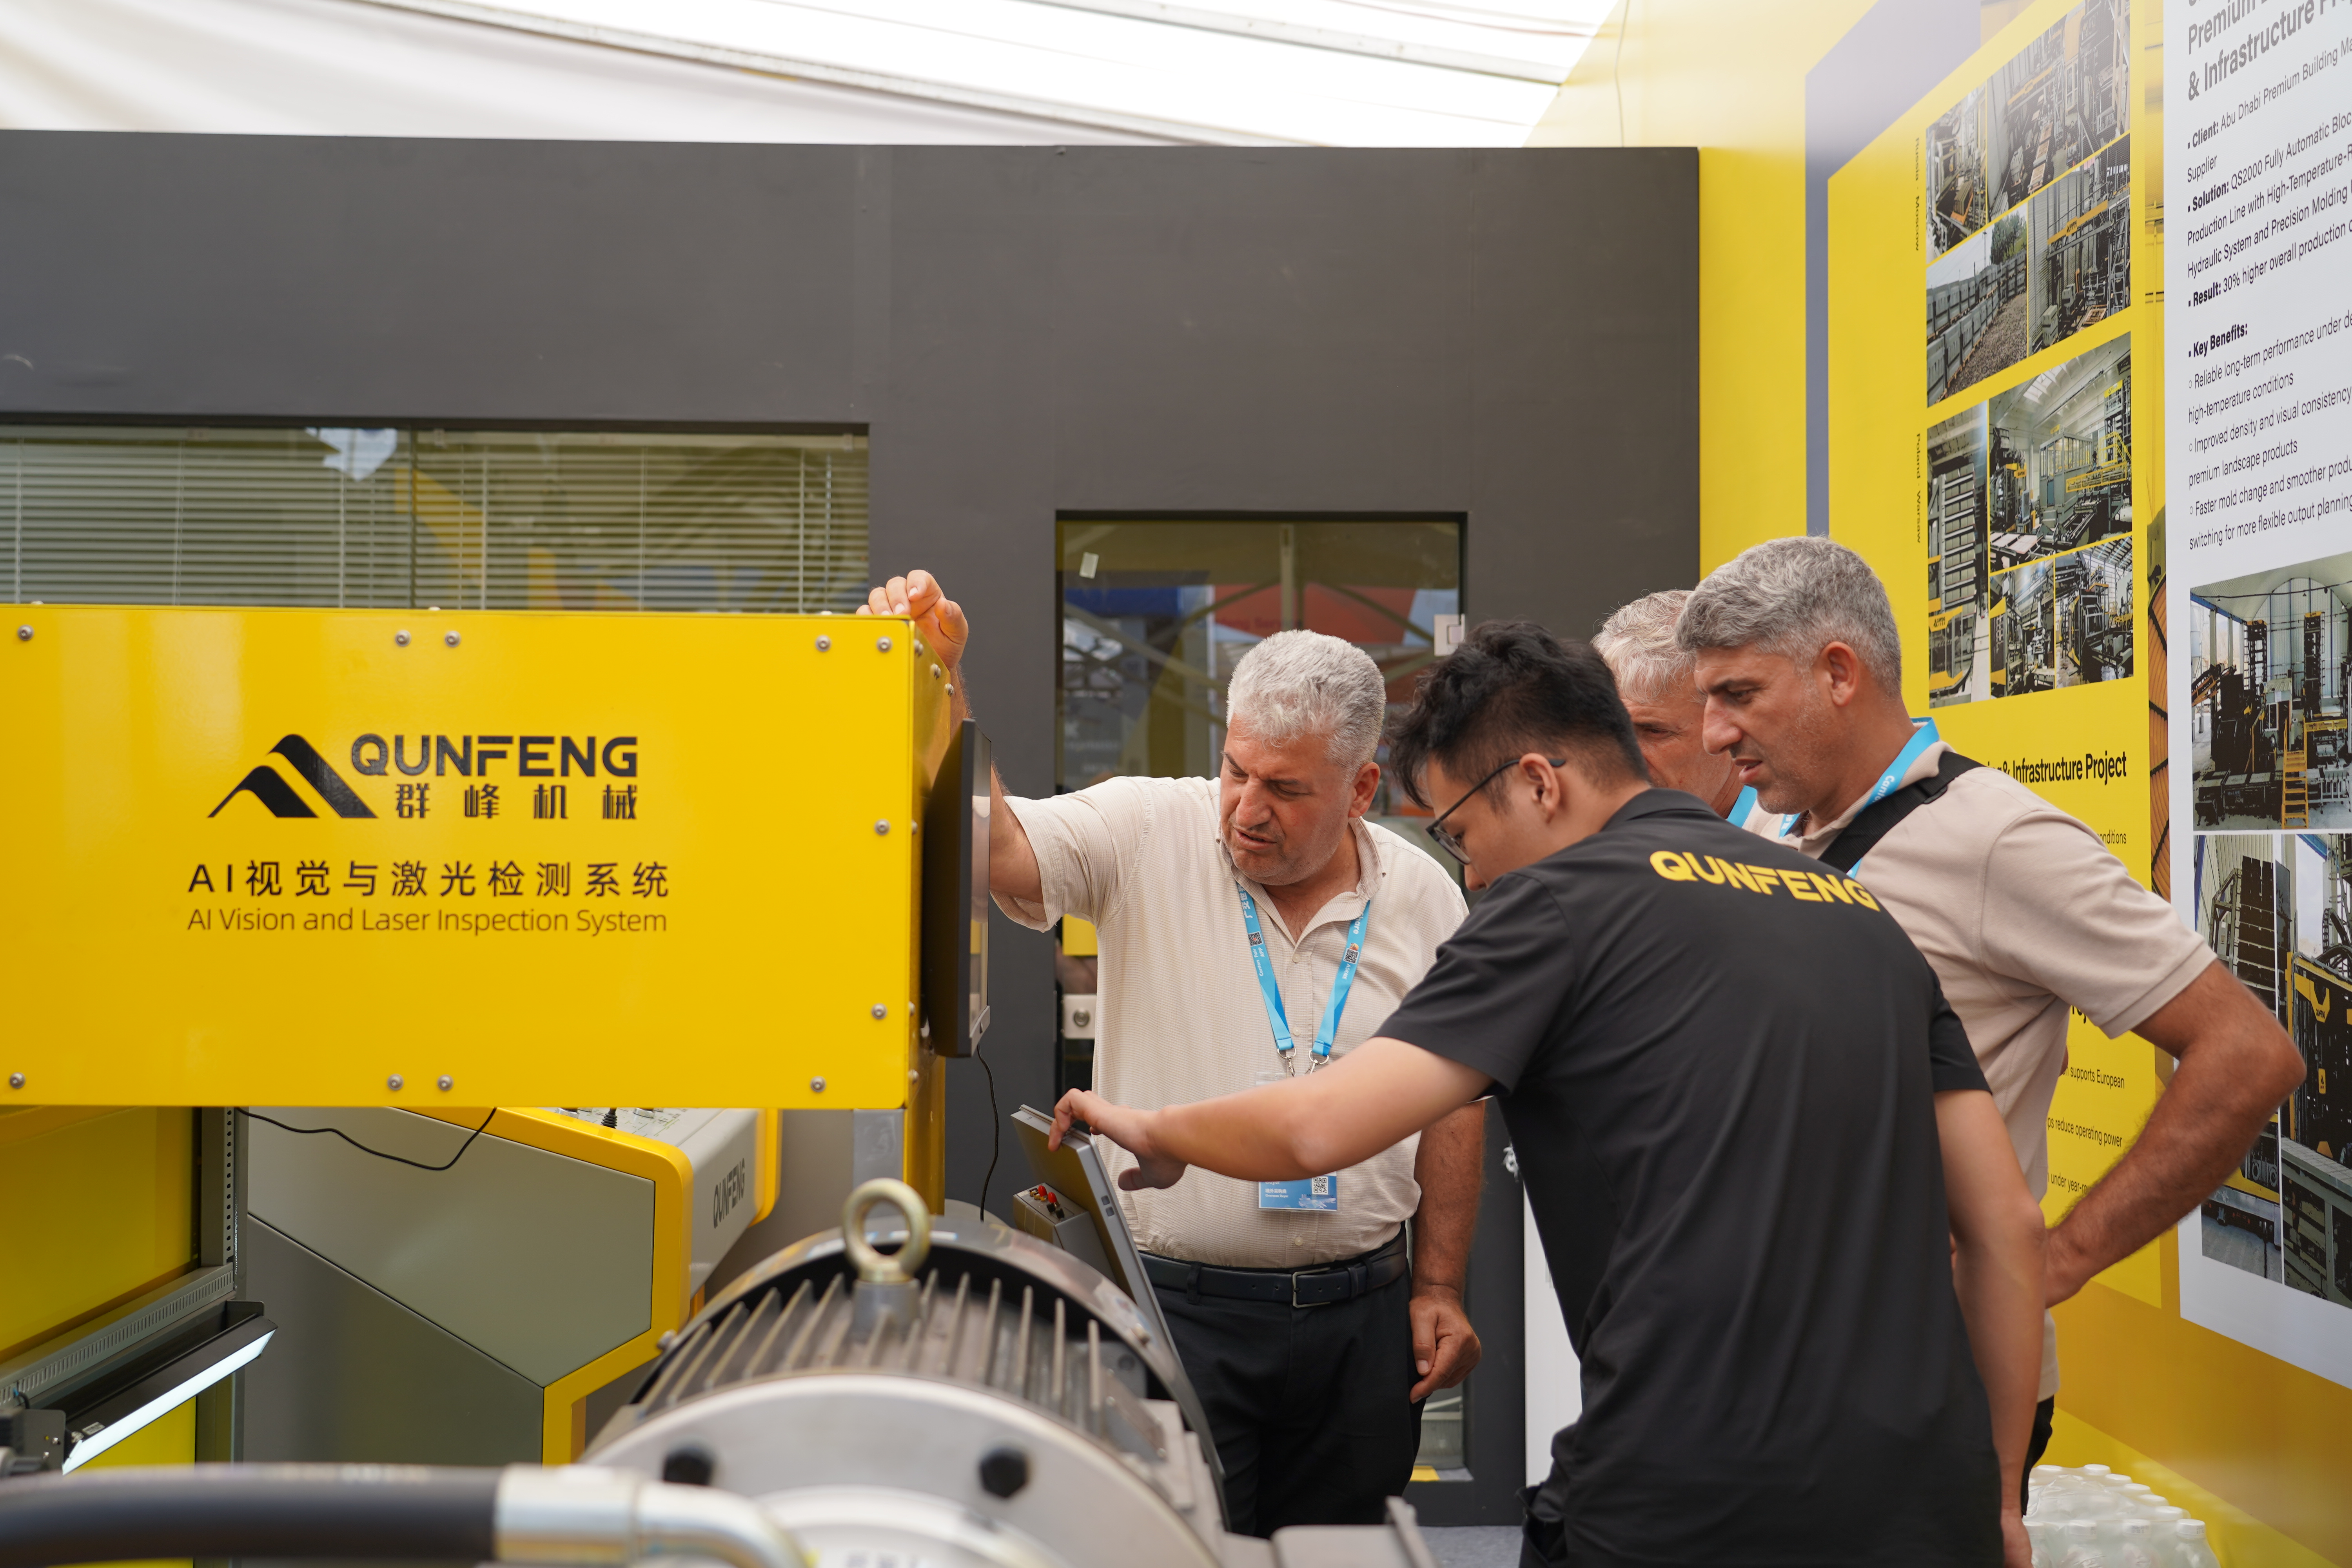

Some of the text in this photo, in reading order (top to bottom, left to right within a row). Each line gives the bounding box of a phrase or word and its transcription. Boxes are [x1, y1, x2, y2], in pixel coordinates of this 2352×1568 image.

[2189, 0, 2256, 54] Premium
[2189, 0, 2314, 101] & Infrastructure
[2193, 122, 2218, 147] Client:
[2221, 112, 2235, 131] Abu
[2239, 92, 2260, 120] Dhabi
[2264, 73, 2299, 105] Premium
[2303, 49, 2337, 80] Building
[2188, 156, 2217, 182] Supplier
[2193, 182, 2229, 211] Solution:
[2232, 160, 2262, 190] QS2000
[2265, 149, 2283, 171] Fully
[2286, 123, 2329, 160] Automatic
[2188, 216, 2227, 246] Production
[2230, 206, 2245, 224] Line
[2248, 192, 2264, 214] with
[2189, 249, 2221, 279] Hydraulic
[2224, 236, 2251, 261] System
[2254, 222, 2268, 244] and
[2272, 207, 2308, 235] Precision
[2312, 186, 2347, 215] Molding
[2194, 282, 2221, 307] Result:
[2223, 272, 2239, 292] 30%
[2243, 261, 2267, 284] higher
[2270, 243, 2296, 270] overall
[2299, 223, 2345, 260] production
[2194, 324, 2247, 357] Key Benefits:
[2195, 365, 2222, 388] Reliable
[2225, 352, 2260, 377] long-term
[2264, 330, 2314, 365] performance
[2317, 318, 2341, 339] under
[2189, 373, 2293, 423] high-temperature conditions
[2195, 387, 2351, 453] Improved density and visual consistency
[2189, 439, 2297, 490] premium landscape products
[2196, 499, 2216, 515] Faster
[2220, 489, 2236, 509] mold
[2239, 485, 2267, 503] change
[2270, 475, 2284, 494] and
[2287, 466, 2325, 489] smoother
[2190, 529, 2222, 550] switching
[2225, 524, 2234, 540] for
[2237, 522, 2256, 537] more
[2259, 510, 2285, 531] flexible
[2288, 503, 2314, 524] output
[352, 734, 637, 777] QUNFENG
[2013, 756, 2082, 783] Infrastructure
[2086, 751, 2126, 785] Project
[396, 783, 637, 819] 群峰机械
[1872, 775, 1895, 802] Canto
[2097, 829, 2127, 844] onditions
[189, 860, 668, 898] AI视觉与激光检测系统
[1649, 851, 1880, 912] QUNFENG
[188, 908, 666, 936] AI Vision and Laser Inspection System
[1353, 913, 1364, 935] hare
[1343, 964, 1351, 980] ASKME
[2071, 1067, 2095, 1082] supports
[2097, 1069, 2124, 1089] European
[2056, 1118, 2074, 1134] reduce
[2076, 1125, 2102, 1145] operating
[2104, 1133, 2122, 1147] power
[713, 1158, 745, 1229] QUNFENG
[2051, 1173, 2066, 1187] under
